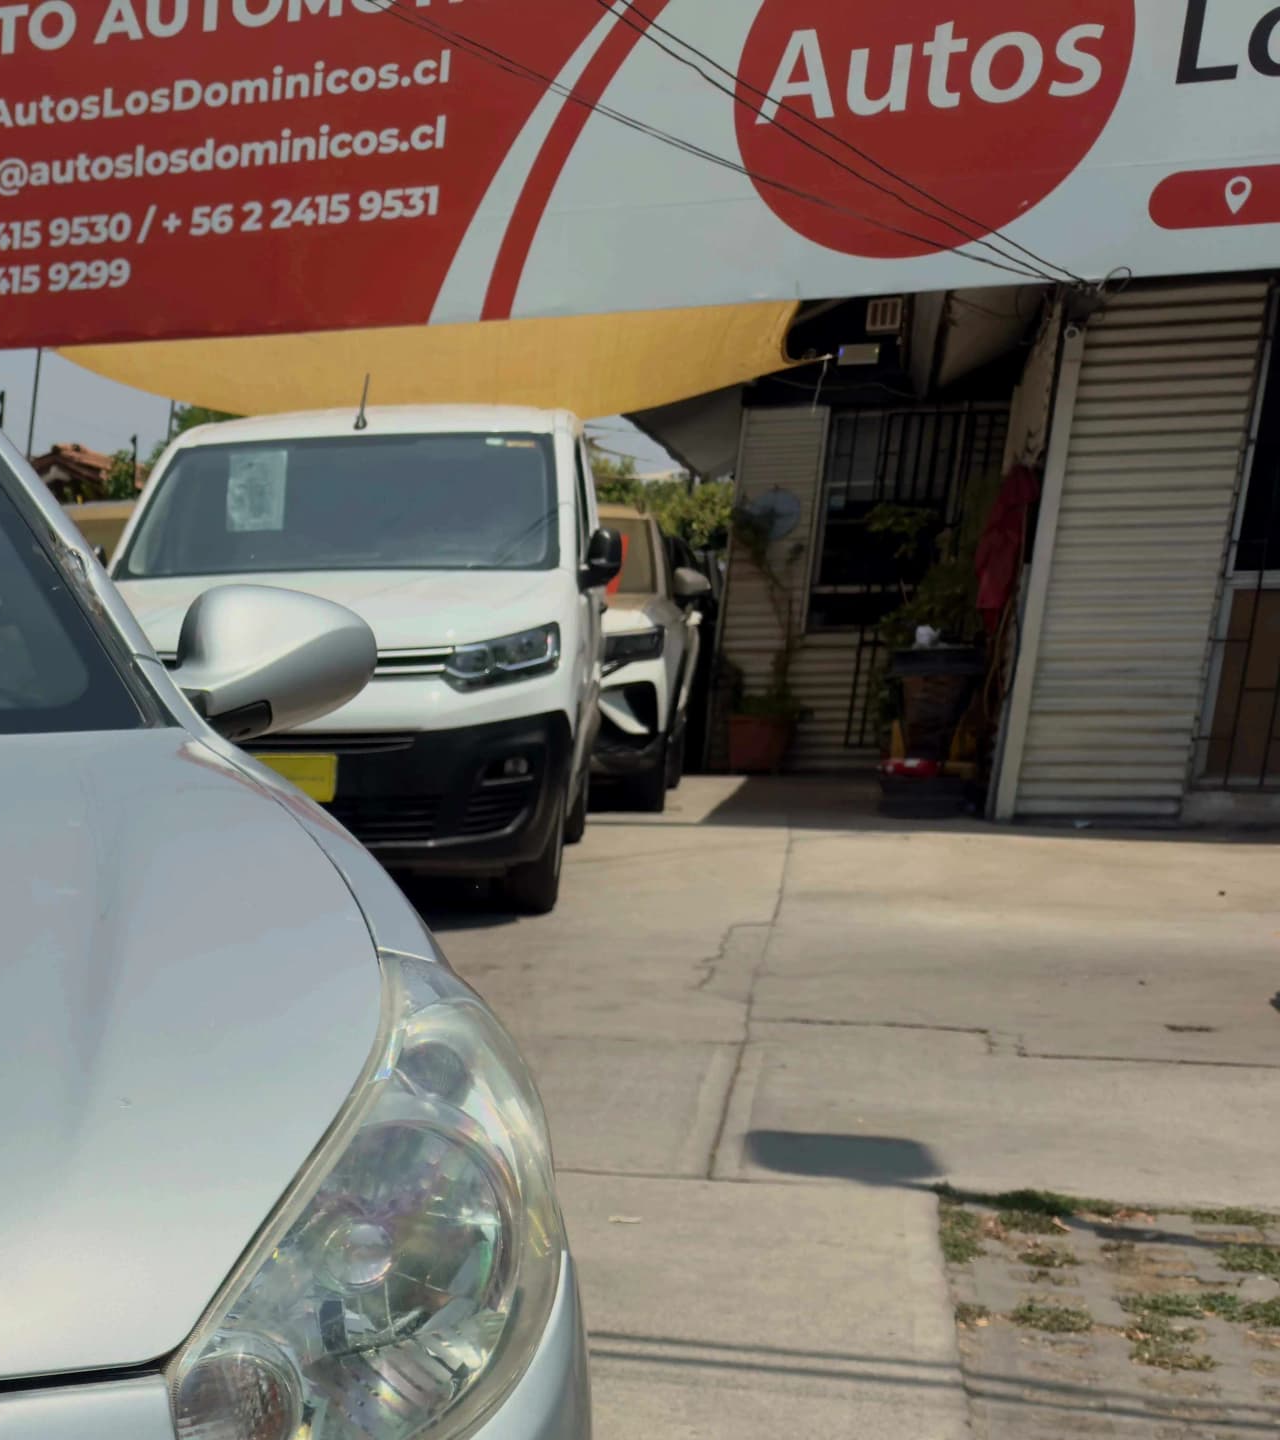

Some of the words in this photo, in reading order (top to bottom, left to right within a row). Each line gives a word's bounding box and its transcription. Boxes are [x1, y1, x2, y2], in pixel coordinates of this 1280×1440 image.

[754, 20, 1105, 125] Autos
[48, 212, 132, 247] 9530
[189, 203, 234, 236] 56
[240, 201, 263, 232] 2
[270, 193, 351, 229] 2415
[358, 185, 440, 222] 9531
[48, 258, 131, 292] 9299
